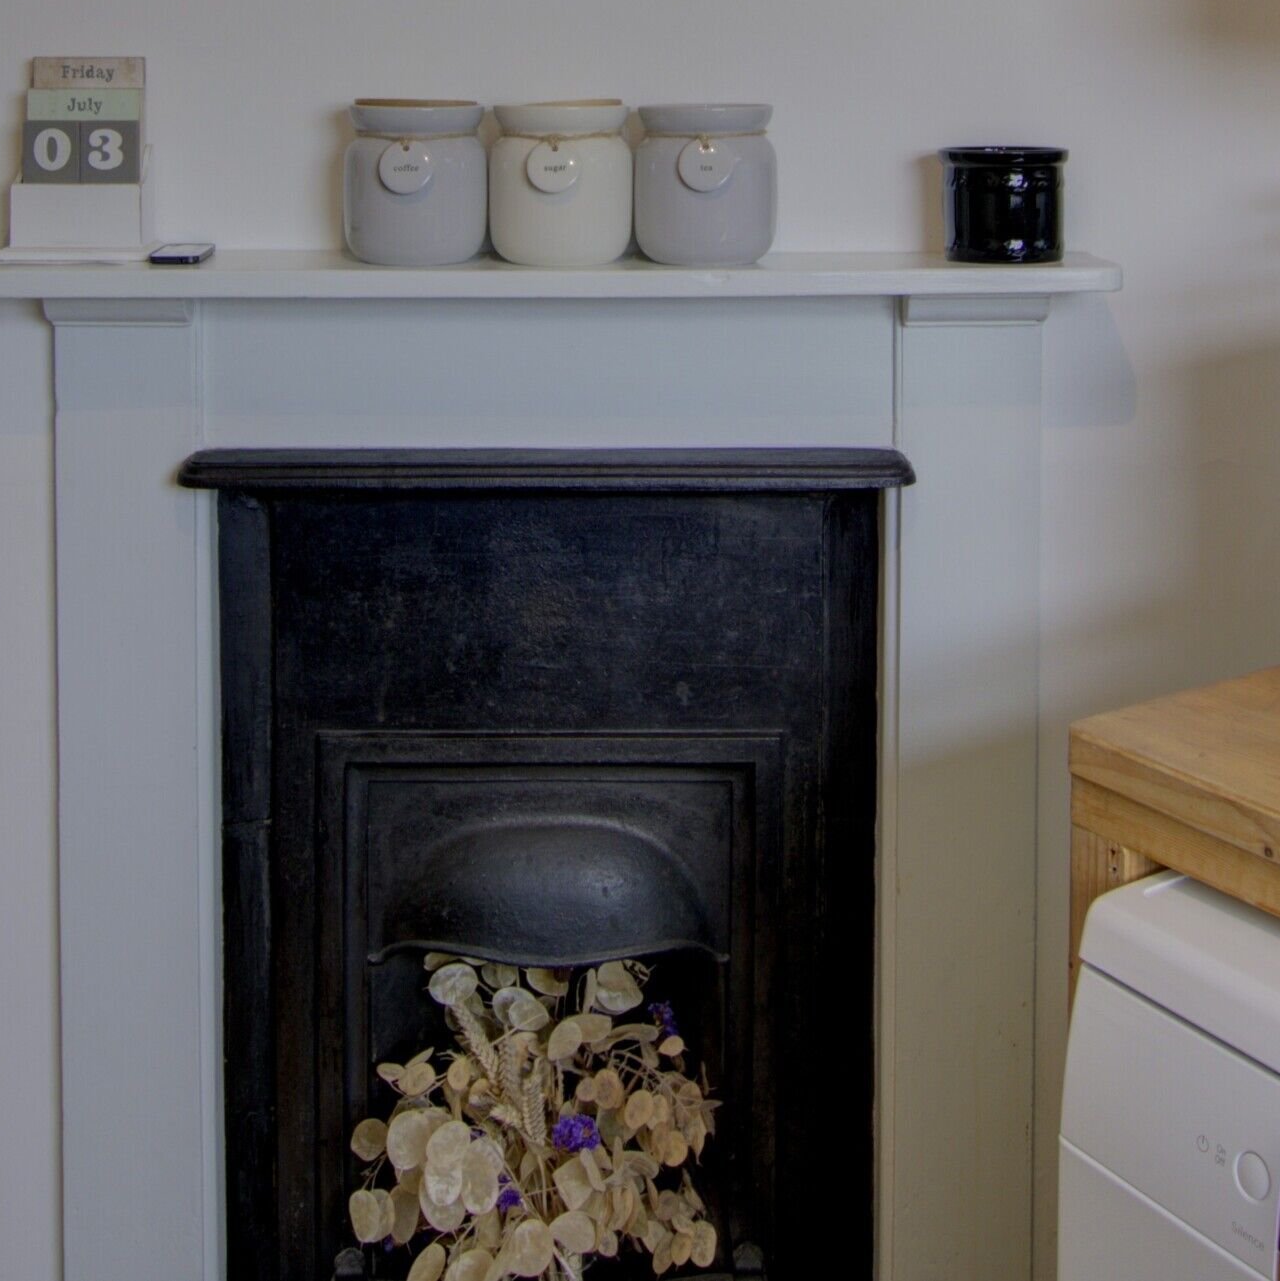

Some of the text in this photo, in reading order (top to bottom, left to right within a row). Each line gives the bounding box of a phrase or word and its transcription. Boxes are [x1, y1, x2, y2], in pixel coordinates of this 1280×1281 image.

[61, 65, 115, 82] Friday
[67, 97, 103, 115] July
[393, 164, 419, 172] coffee
[544, 165, 566, 173] sugar
